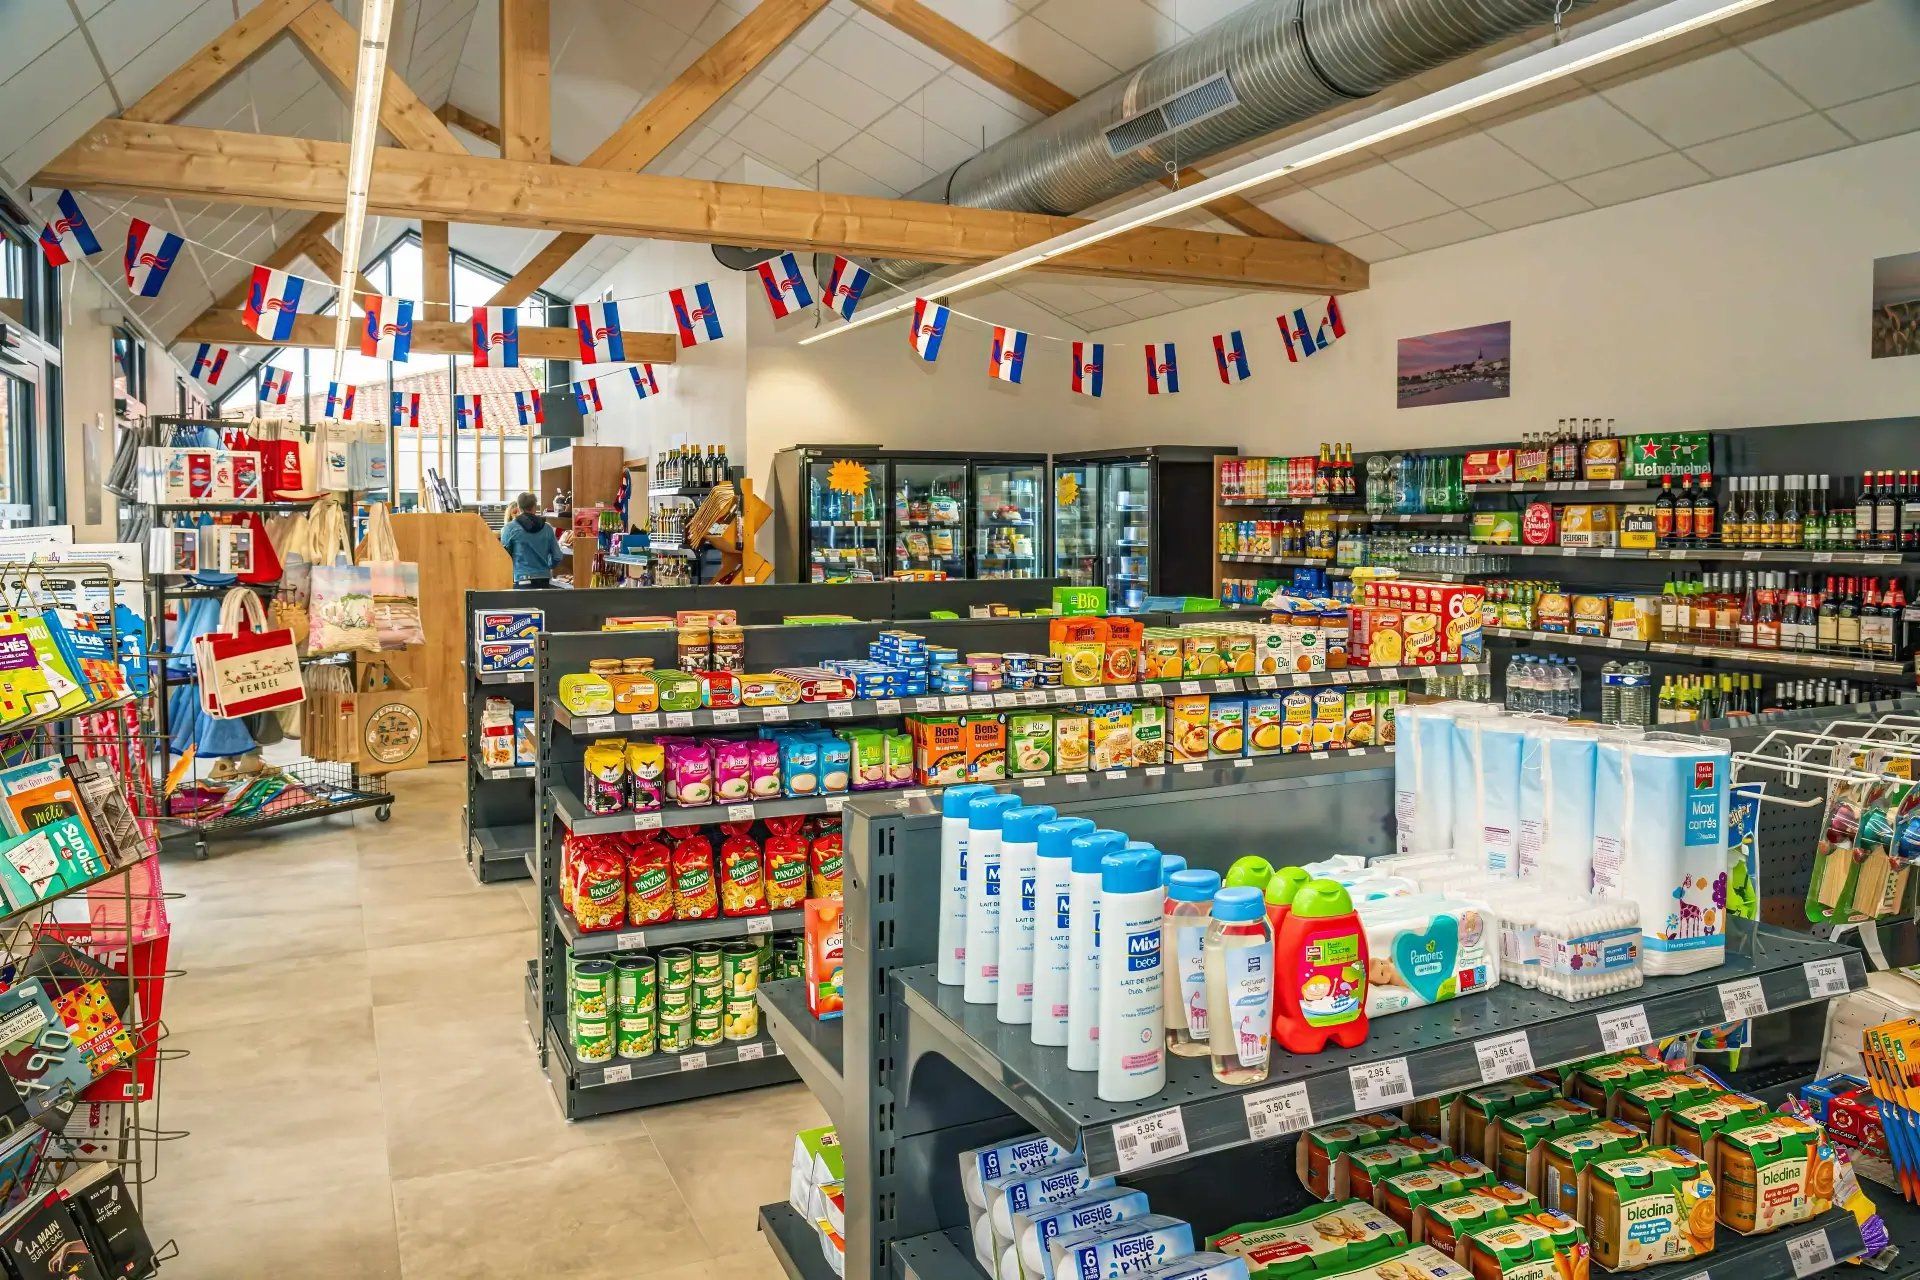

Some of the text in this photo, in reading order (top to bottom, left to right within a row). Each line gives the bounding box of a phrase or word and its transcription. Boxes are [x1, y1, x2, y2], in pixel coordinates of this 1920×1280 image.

[1562, 534, 1589, 542] PELFORTH
[1077, 593, 1099, 609] Bio
[505, 617, 531, 636] BOUDOIR
[503, 647, 529, 665] BOUDOIR
[1277, 656, 1290, 668] Bio
[1311, 654, 1325, 666] Bio
[239, 677, 281, 697] VENDÉE
[1287, 697, 1308, 707] Tipiak
[1319, 695, 1340, 705] Tipiak
[935, 726, 960, 737] Ben's
[974, 724, 999, 734] Ben's
[1032, 722, 1044, 731] Riz
[693, 762, 705, 770] Riz
[734, 758, 745, 766] Riz
[1692, 802, 1715, 815] Maxi
[1688, 818, 1718, 830] carrés
[62, 823, 97, 877] SUDOKU
[731, 860, 759, 878] PANZANI
[774, 863, 806, 880] PANZANI
[635, 871, 667, 890] PANZANI
[680, 871, 710, 889] PANZANI
[590, 879, 621, 898] PANZANI
[1131, 936, 1160, 953] Mixa
[1410, 949, 1444, 965] Pampers
[10, 1012, 43, 1034] MILLIARDS
[1629, 1020, 1634, 1028] €
[94, 1025, 119, 1044] APÉRO
[1493, 1046, 1515, 1059] 3.95 €
[1367, 1066, 1391, 1079] 2.95 €
[1266, 1101, 1283, 1114] 3.50
[1285, 1099, 1291, 1108] €
[1137, 1120, 1163, 1135] 5.95 €
[1012, 1140, 1049, 1160] Nestlé
[987, 1153, 998, 1168] 6
[1041, 1170, 1079, 1194] Nestlé
[1015, 1186, 1026, 1202] 6
[1072, 1204, 1112, 1229] Nestlé
[1046, 1221, 1057, 1237] 6
[25, 1220, 60, 1256] LA MAIN
[30, 1229, 64, 1264] SUR LE SAC
[1112, 1236, 1155, 1259] Nestlé
[1085, 1250, 1096, 1268] 6
